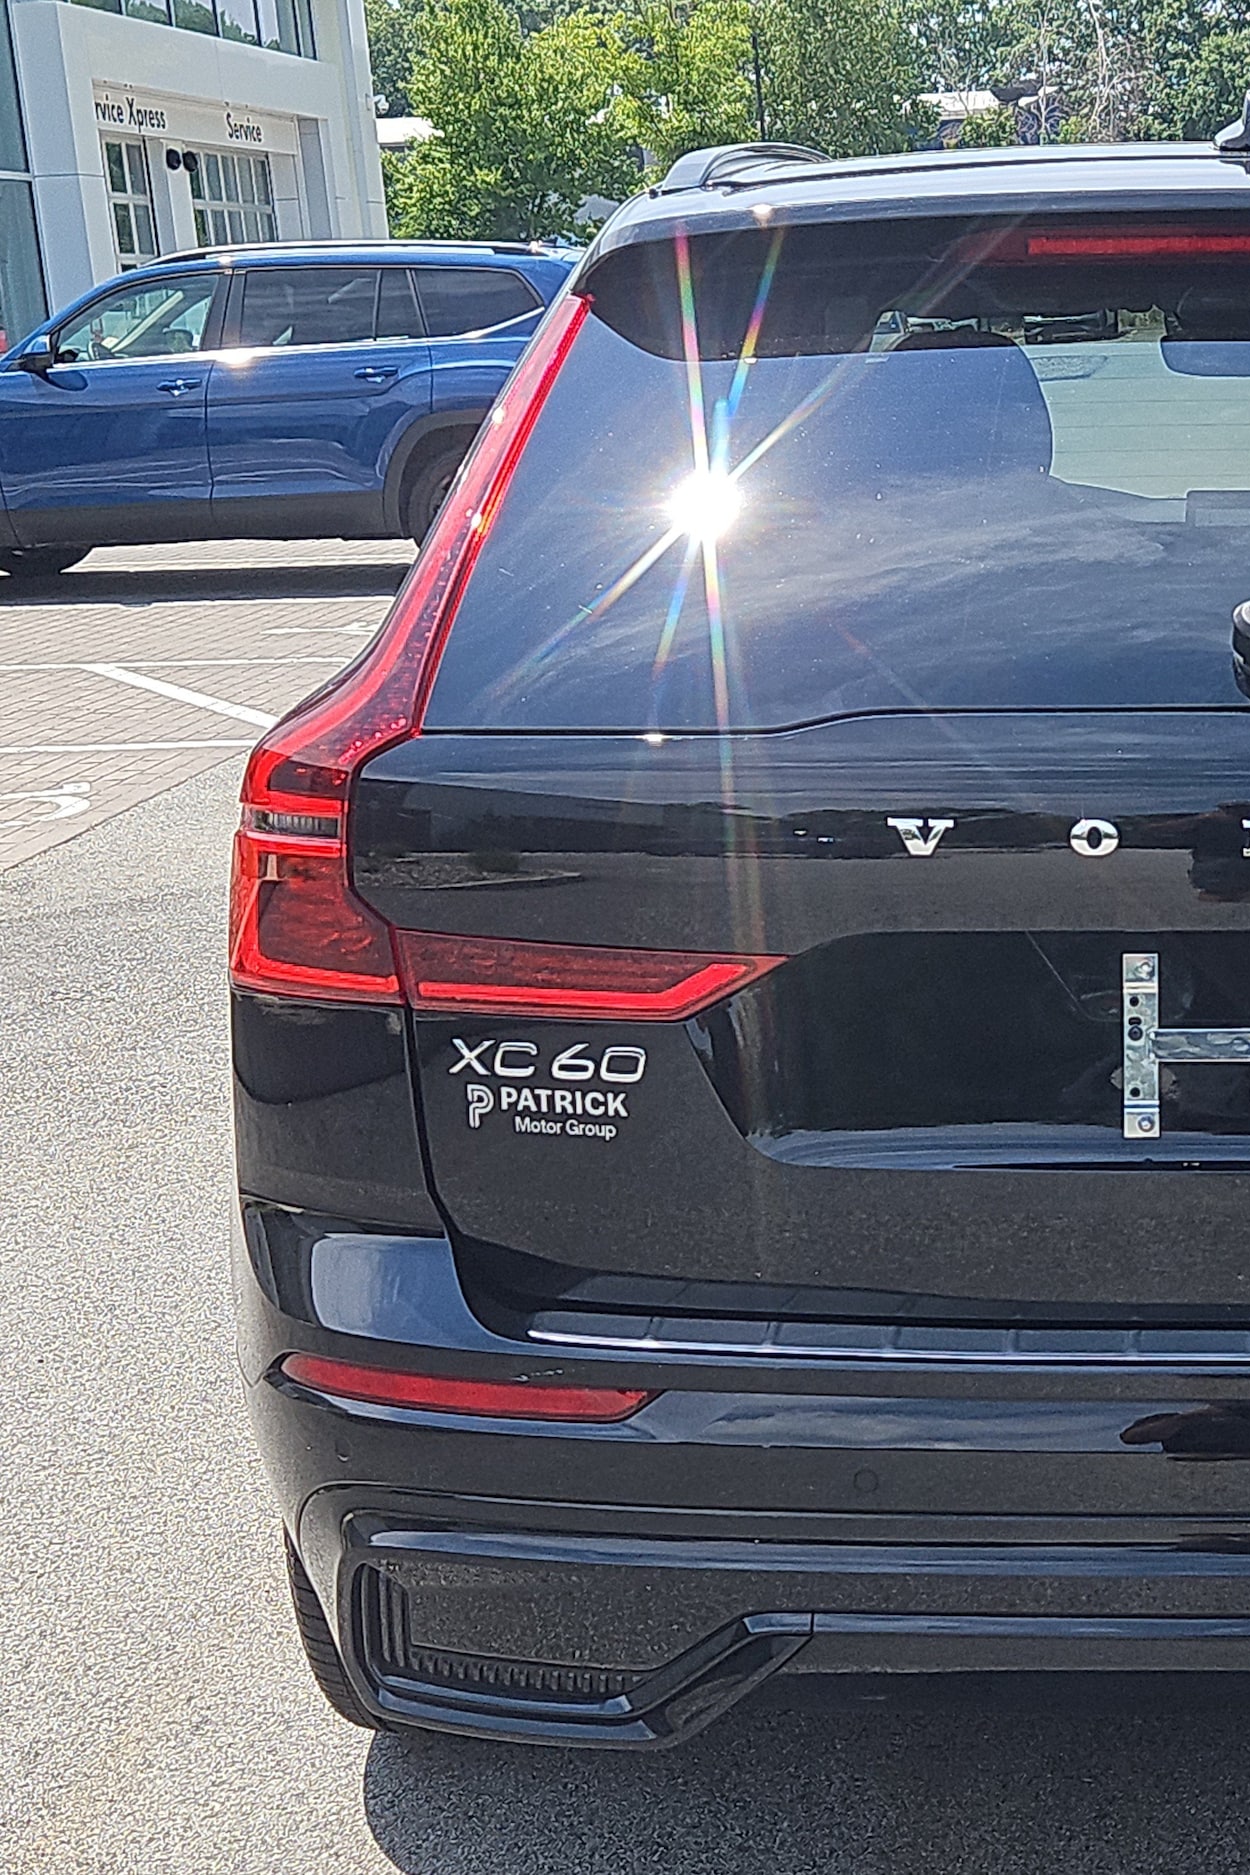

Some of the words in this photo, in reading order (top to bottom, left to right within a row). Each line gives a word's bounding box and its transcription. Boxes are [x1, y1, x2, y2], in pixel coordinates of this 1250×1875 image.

[126, 97, 166, 133] Xpress
[225, 112, 263, 143] Service
[500, 1086, 629, 1118] PATRICK
[514, 1115, 563, 1135] Motor
[565, 1119, 617, 1141] Group
